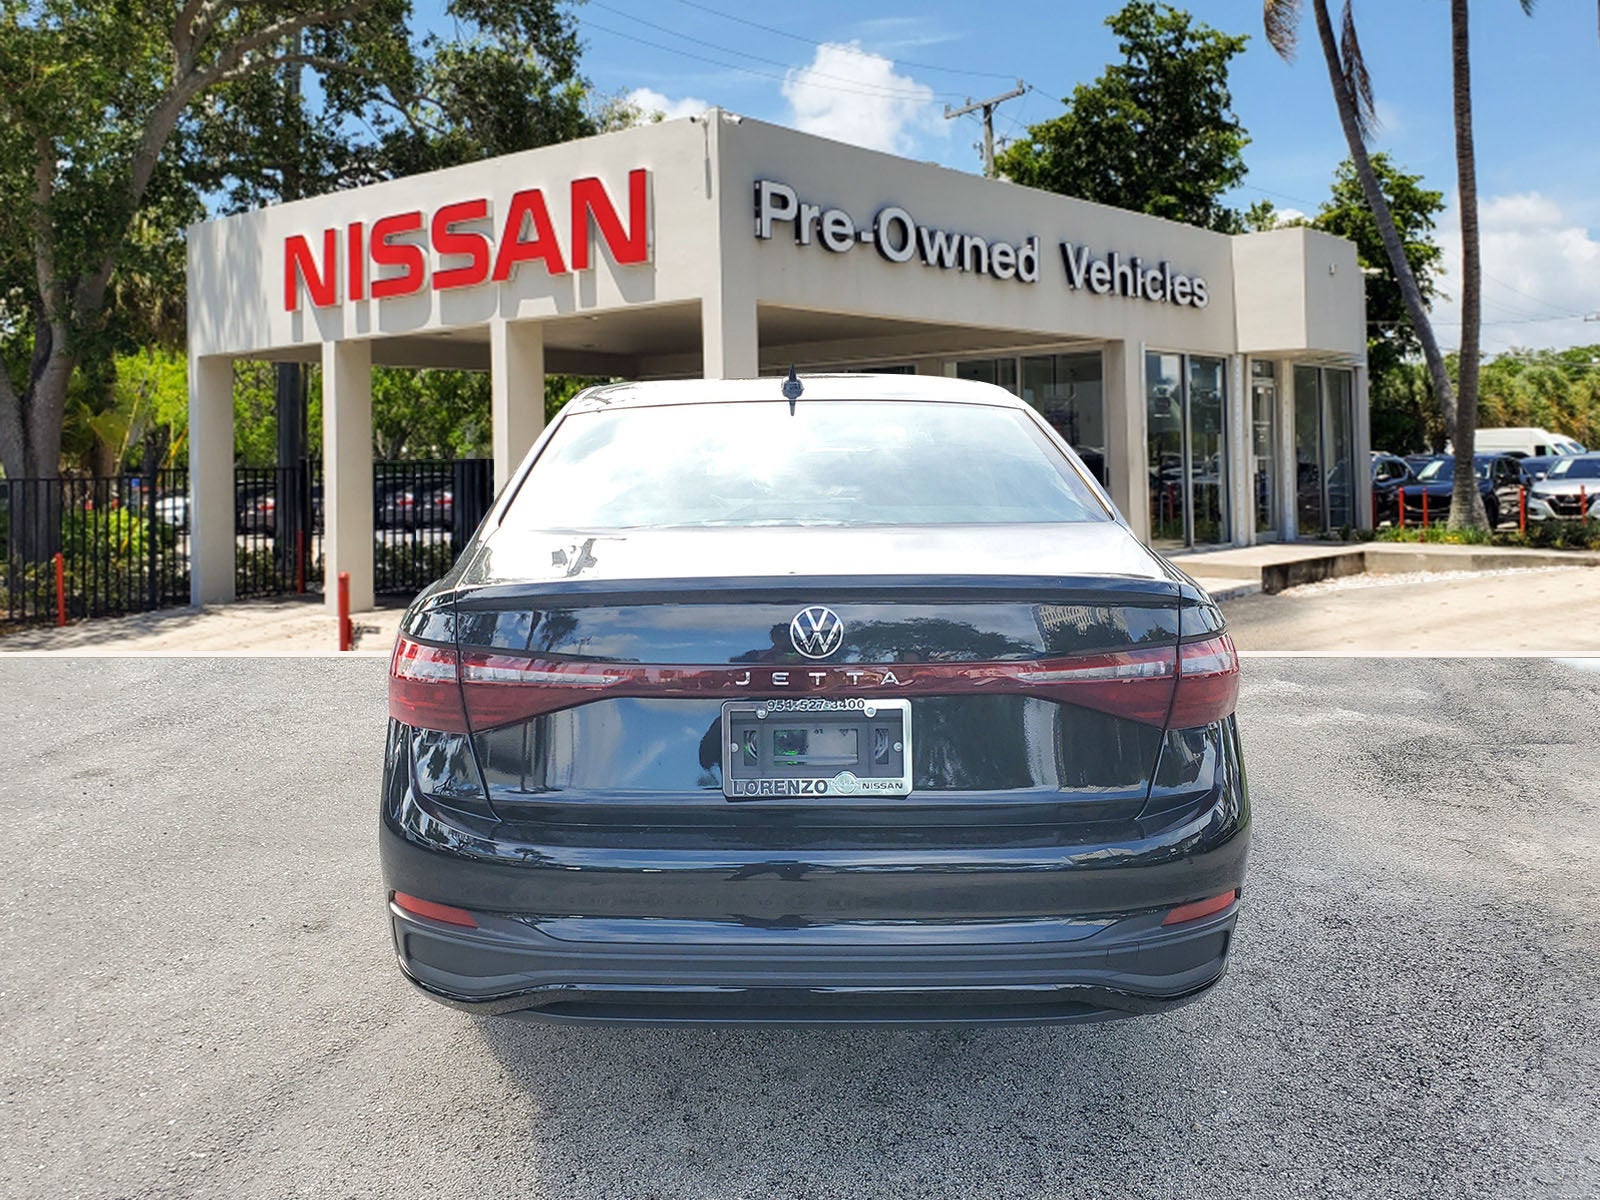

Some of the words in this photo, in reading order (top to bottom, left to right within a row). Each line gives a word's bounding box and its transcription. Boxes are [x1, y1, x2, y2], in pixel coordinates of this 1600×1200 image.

[285, 168, 648, 312] NISSAN
[754, 180, 1040, 283] Pre-Owned
[1061, 242, 1209, 309] Vehicles
[735, 671, 901, 686] JETTA
[733, 779, 829, 796] LORENZO
[861, 781, 904, 790] NISSAN
